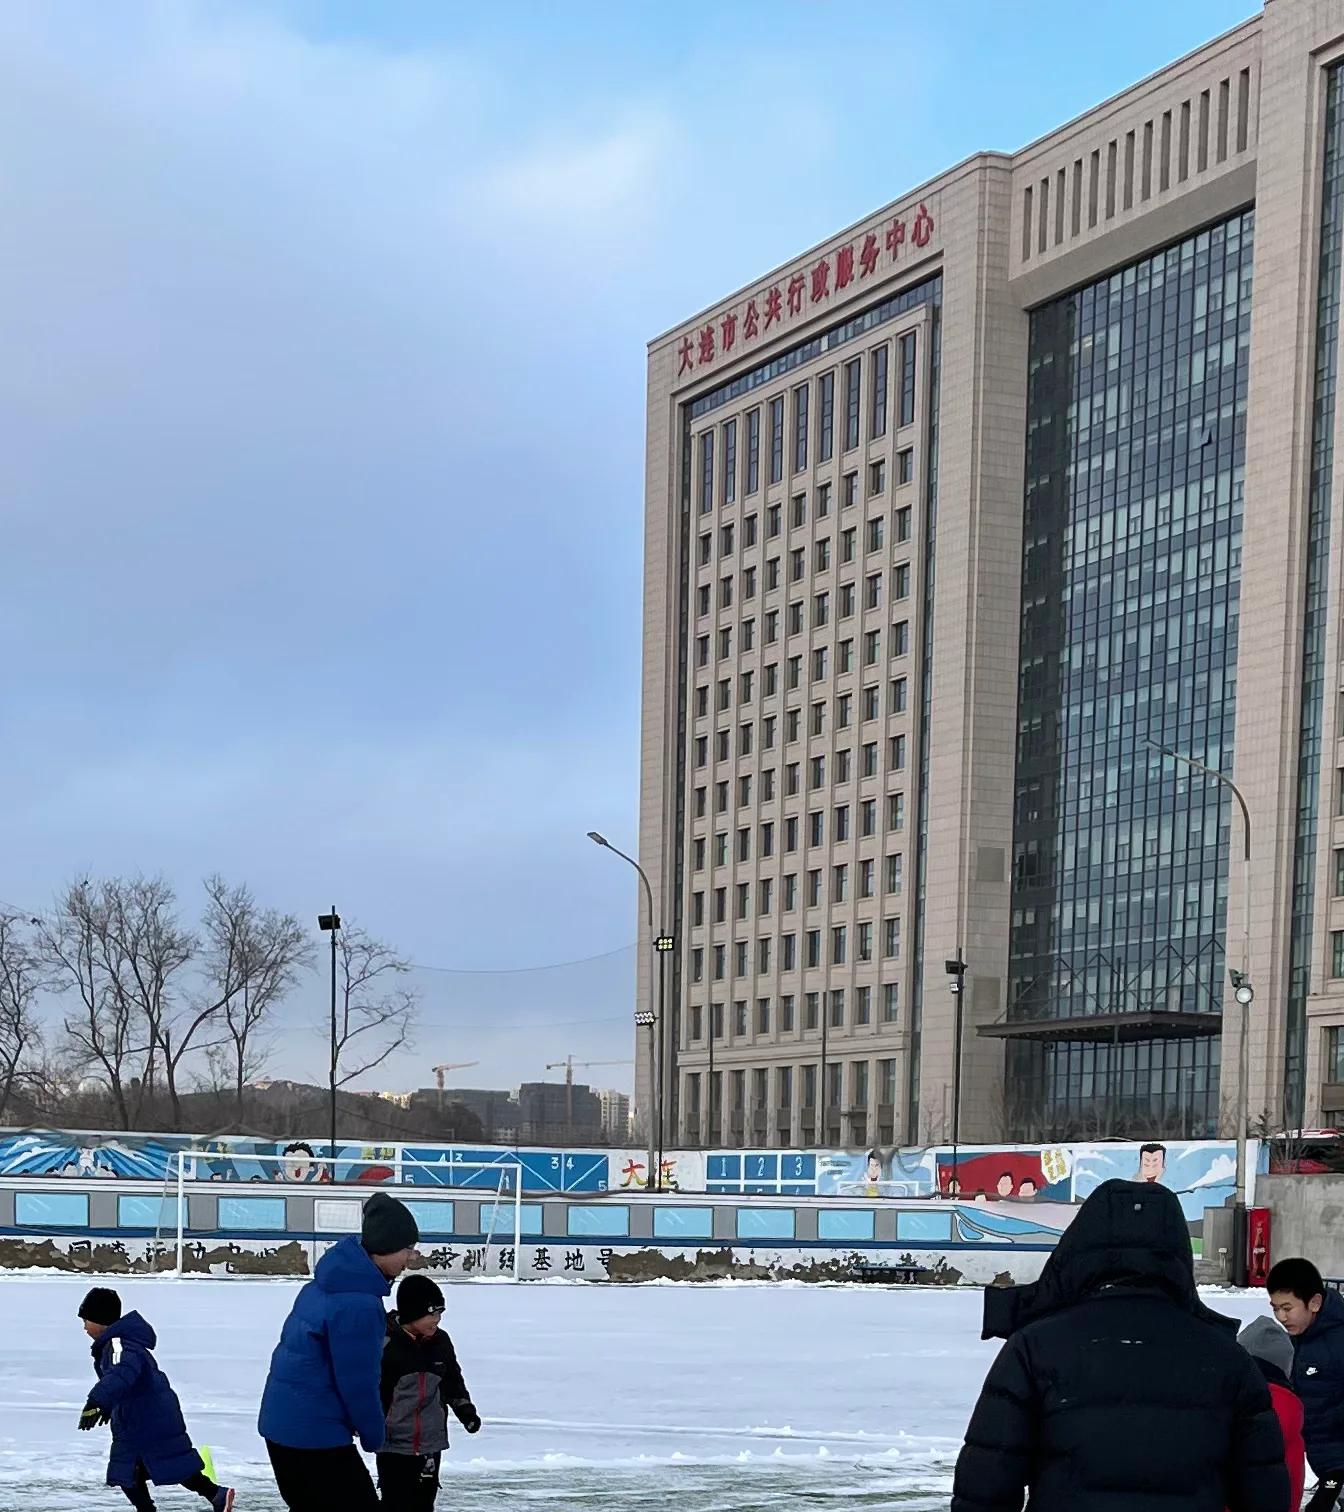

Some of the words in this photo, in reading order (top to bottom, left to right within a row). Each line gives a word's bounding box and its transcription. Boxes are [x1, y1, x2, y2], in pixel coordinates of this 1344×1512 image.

[676, 202, 936, 378] 大连市公共行政服务中心
[550, 1156, 560, 1170] 3
[565, 1156, 575, 1170] 4
[720, 1157, 727, 1177] 1
[757, 1156, 765, 1177] 2
[795, 1155, 804, 1177] 3
